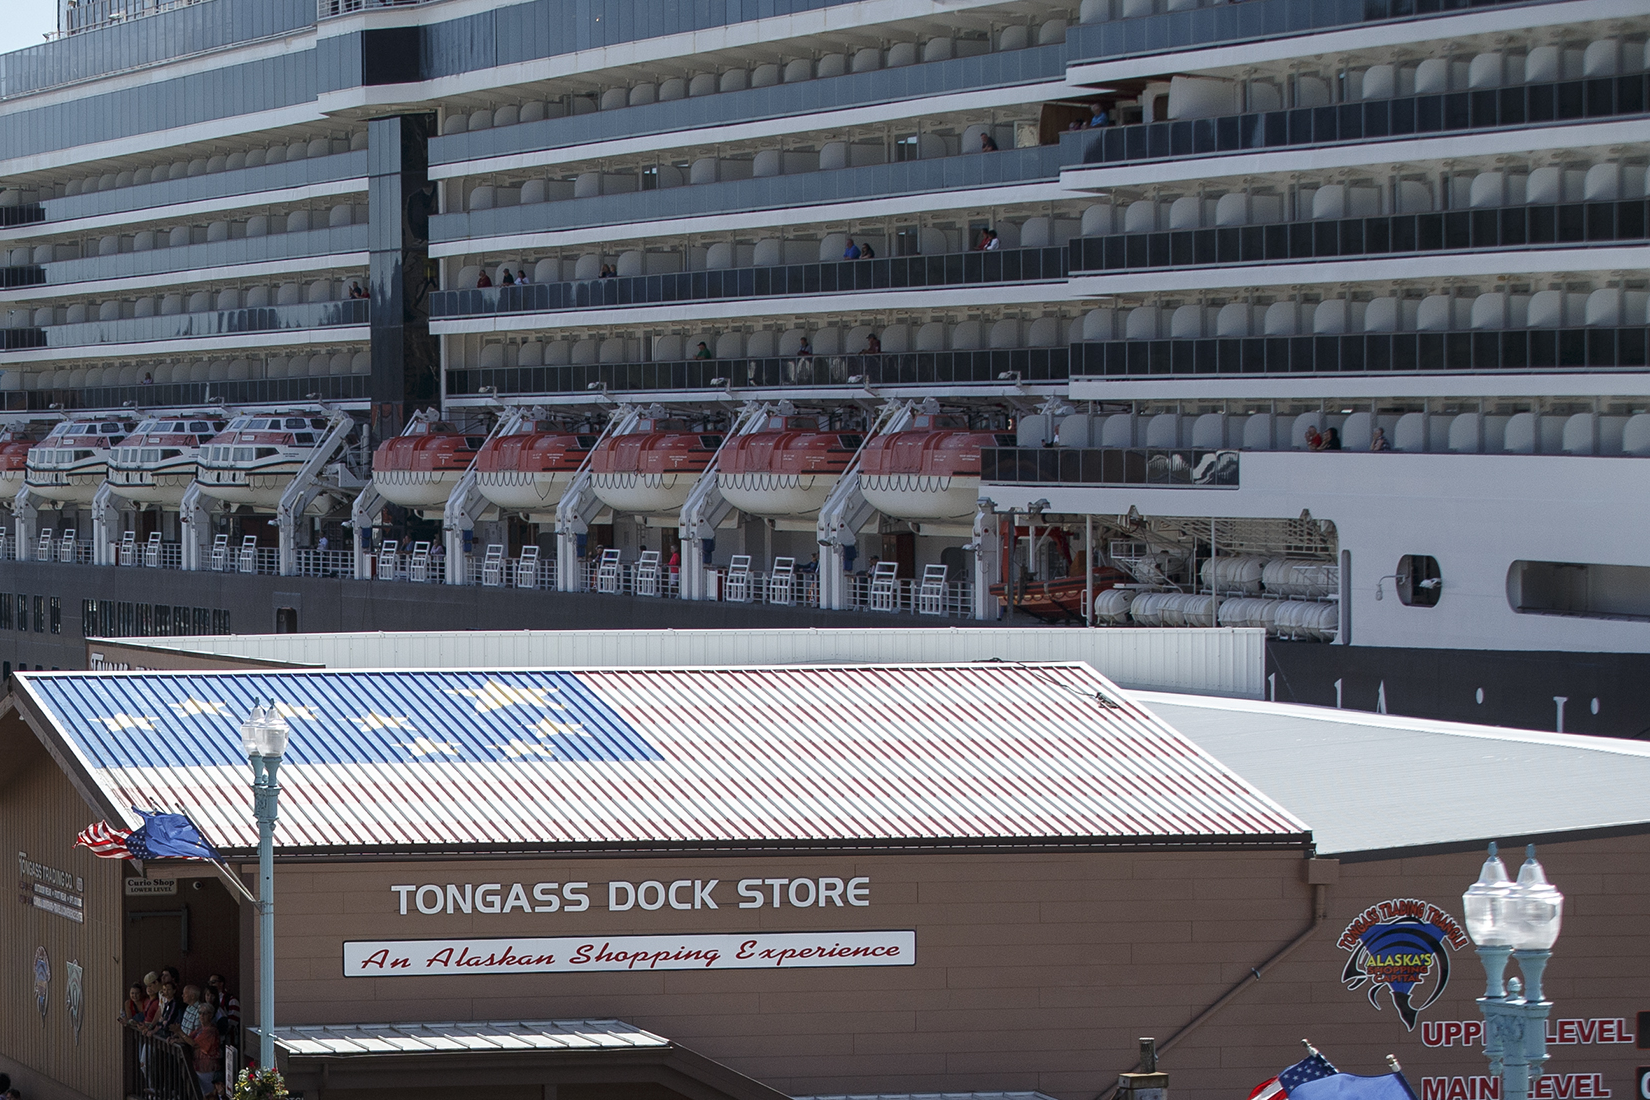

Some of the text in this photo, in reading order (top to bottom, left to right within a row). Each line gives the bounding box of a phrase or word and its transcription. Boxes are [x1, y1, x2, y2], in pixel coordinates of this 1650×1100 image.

[153, 879, 175, 887] Shop
[391, 876, 870, 915] TONGASS DOCK STORE
[1337, 899, 1469, 951] TONGASS TRADING TRIANGLE
[361, 939, 900, 970] An Alaskan Shopping Experience
[1367, 953, 1432, 967] ALASKA'S
[1367, 966, 1428, 975] SHOPPING
[1375, 974, 1422, 983] CAPITAL
[1422, 1018, 1635, 1047] UPP LEVEL
